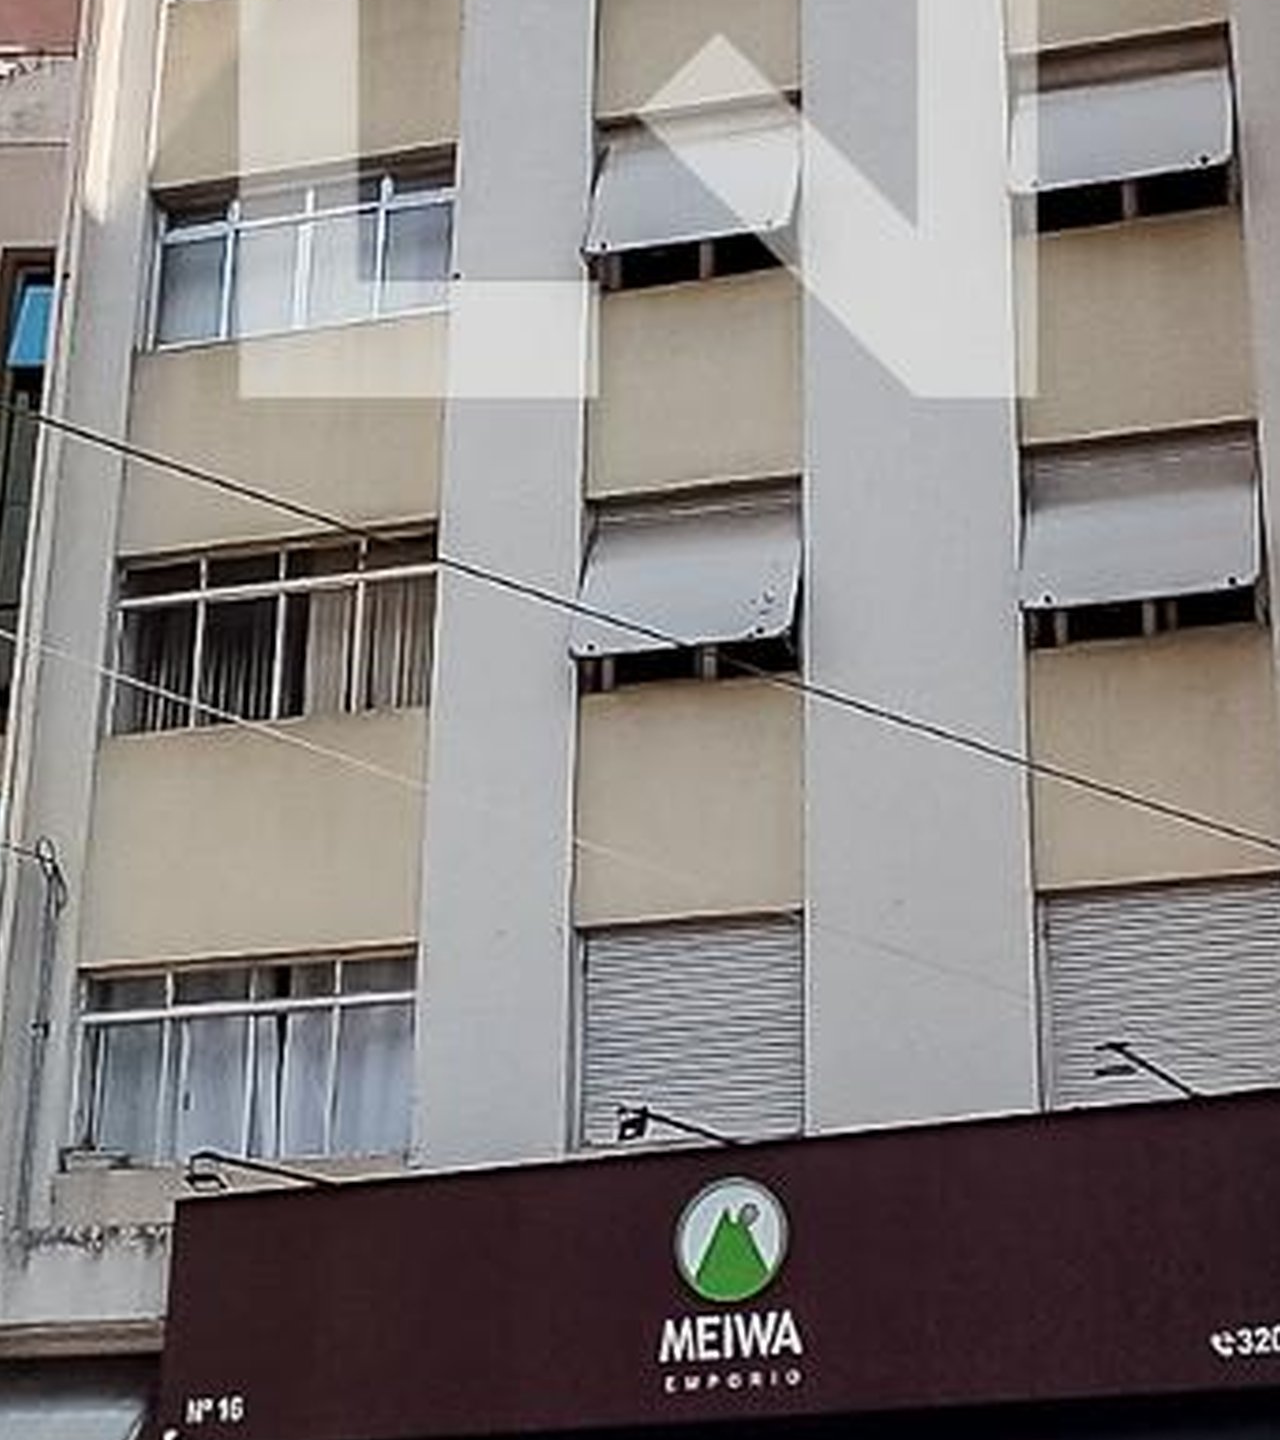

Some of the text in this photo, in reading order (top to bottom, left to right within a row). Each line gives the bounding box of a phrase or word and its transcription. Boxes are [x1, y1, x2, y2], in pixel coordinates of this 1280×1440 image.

[658, 1310, 803, 1364] MEIWA
[663, 1369, 802, 1394] EMPORIO
[217, 1395, 244, 1423] 16
